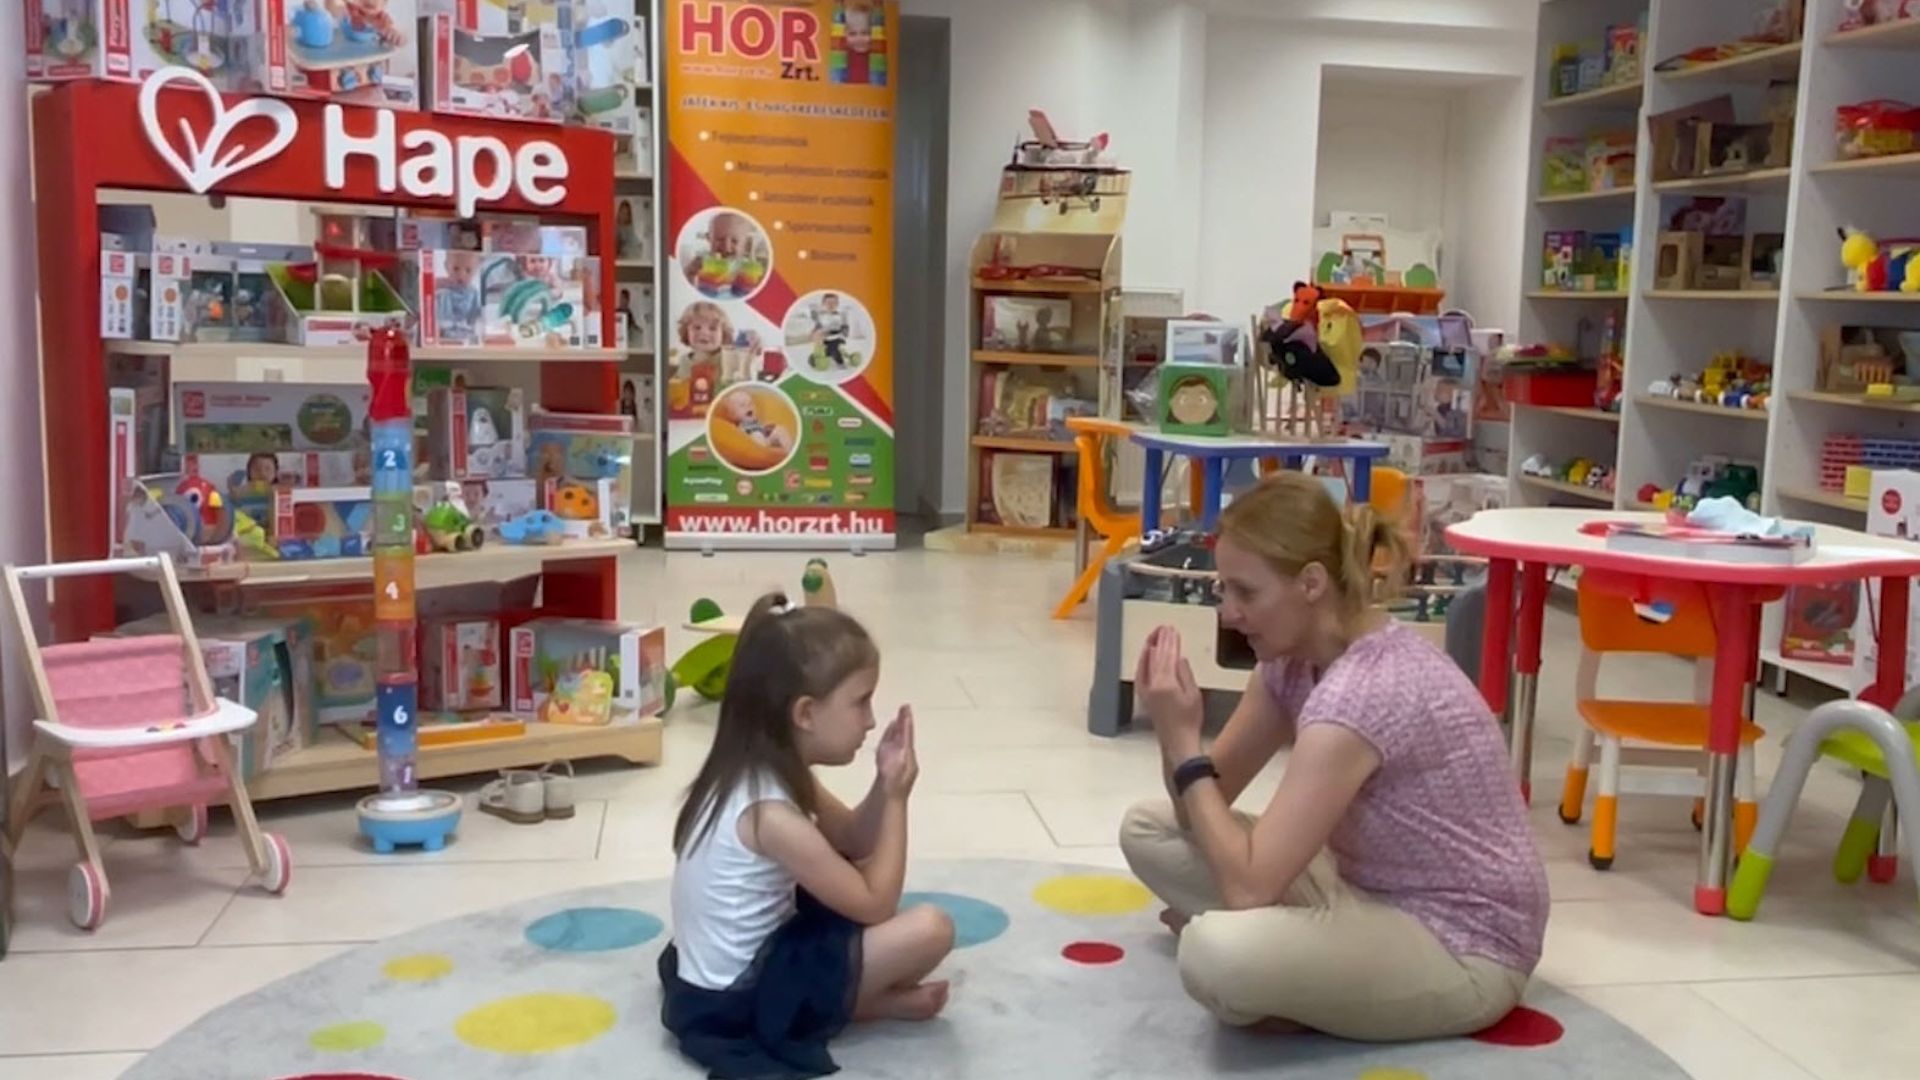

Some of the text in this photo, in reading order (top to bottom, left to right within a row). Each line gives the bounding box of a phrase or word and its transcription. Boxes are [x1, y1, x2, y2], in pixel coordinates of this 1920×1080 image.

[680, 2, 819, 61] HOR
[780, 62, 820, 82] Zrt.
[323, 104, 569, 219] Hape
[383, 450, 397, 468] 2
[392, 513, 406, 532] 3
[679, 509, 884, 533] www.horzrt.hu
[385, 581, 399, 600] 4
[393, 704, 409, 725] 6
